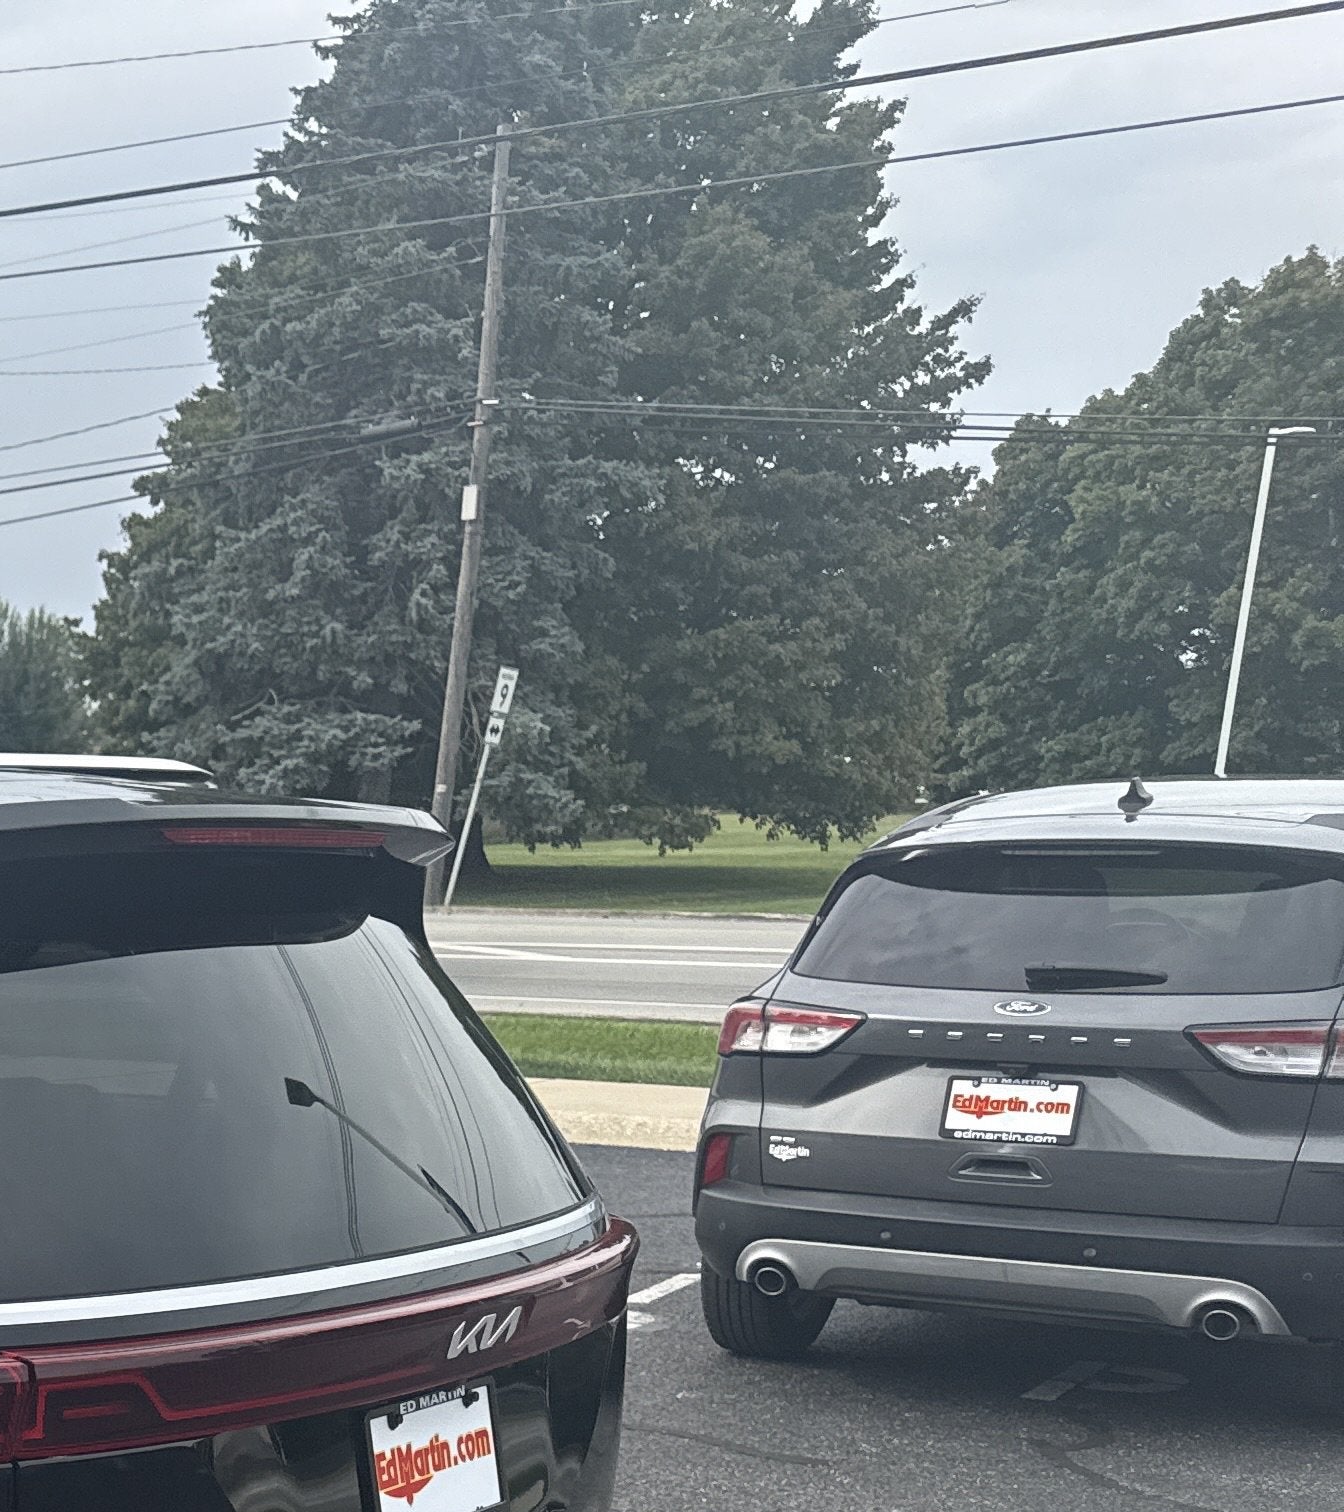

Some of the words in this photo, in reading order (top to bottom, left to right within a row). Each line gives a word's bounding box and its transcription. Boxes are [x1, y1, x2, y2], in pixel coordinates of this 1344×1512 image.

[500, 683, 510, 709] 9
[1001, 1077, 1050, 1087] MARTIN
[951, 1093, 1071, 1115] EdMartin.com
[953, 1128, 1058, 1145] edmartin.com
[399, 1399, 417, 1416] ED
[419, 1384, 466, 1408] MARTIN
[374, 1426, 492, 1492] EdMartin.com
